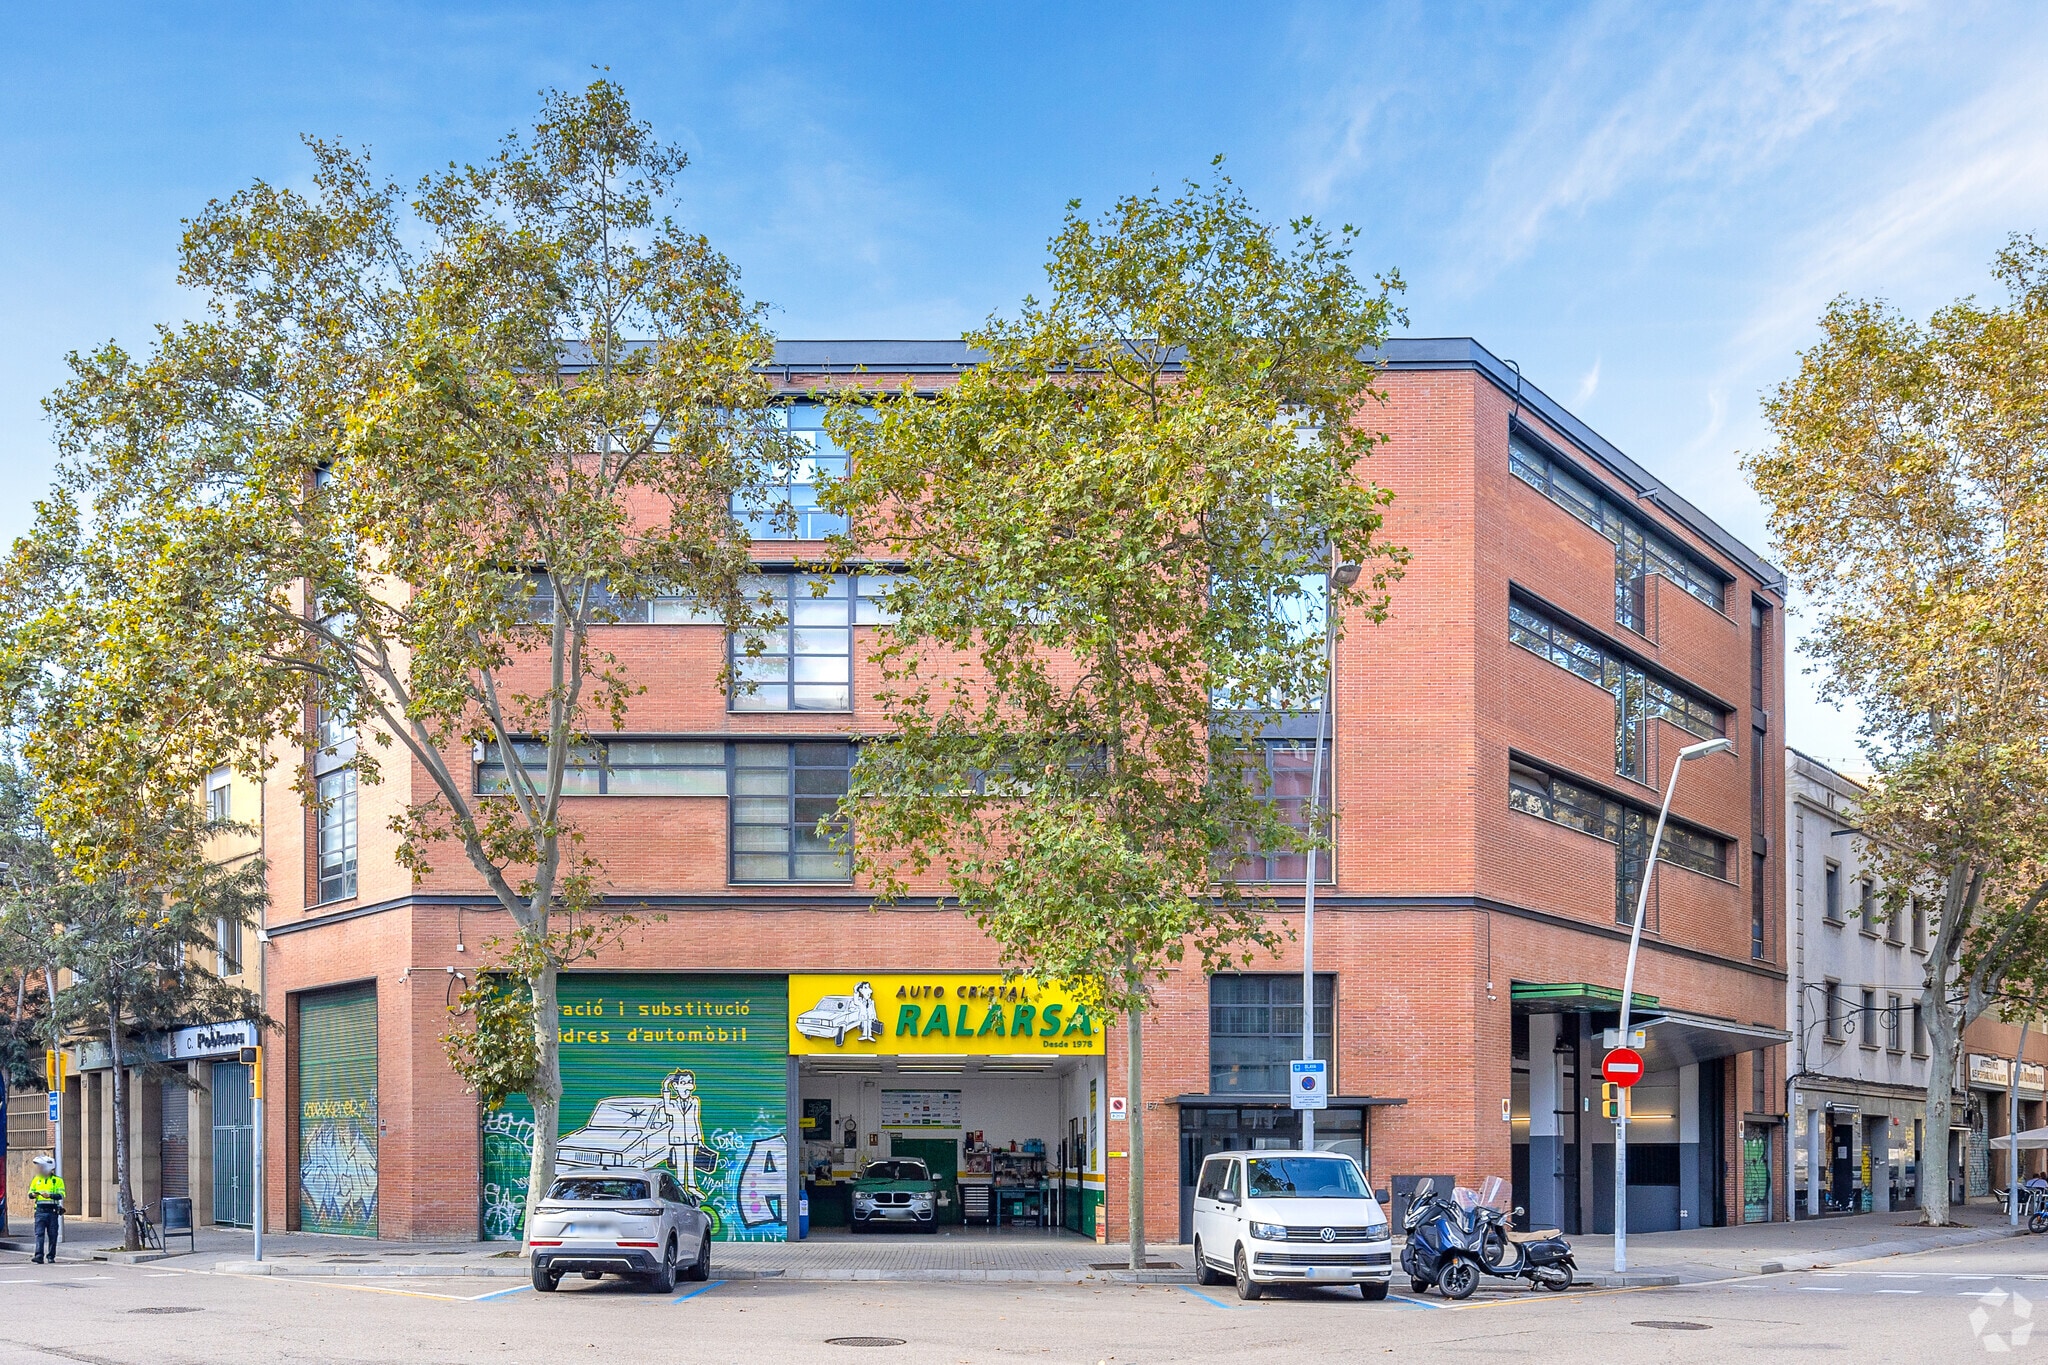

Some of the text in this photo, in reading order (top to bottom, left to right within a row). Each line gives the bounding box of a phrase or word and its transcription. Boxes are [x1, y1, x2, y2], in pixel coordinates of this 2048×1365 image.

[896, 985, 1027, 1000] AUTO CRISTAL
[557, 998, 750, 1017] ació i substitució
[896, 1004, 1093, 1038] RALARSA
[197, 1030, 246, 1050] Poblenou
[627, 1025, 747, 1042] d'automòbil
[1043, 1040, 1094, 1048] Desde 1978
